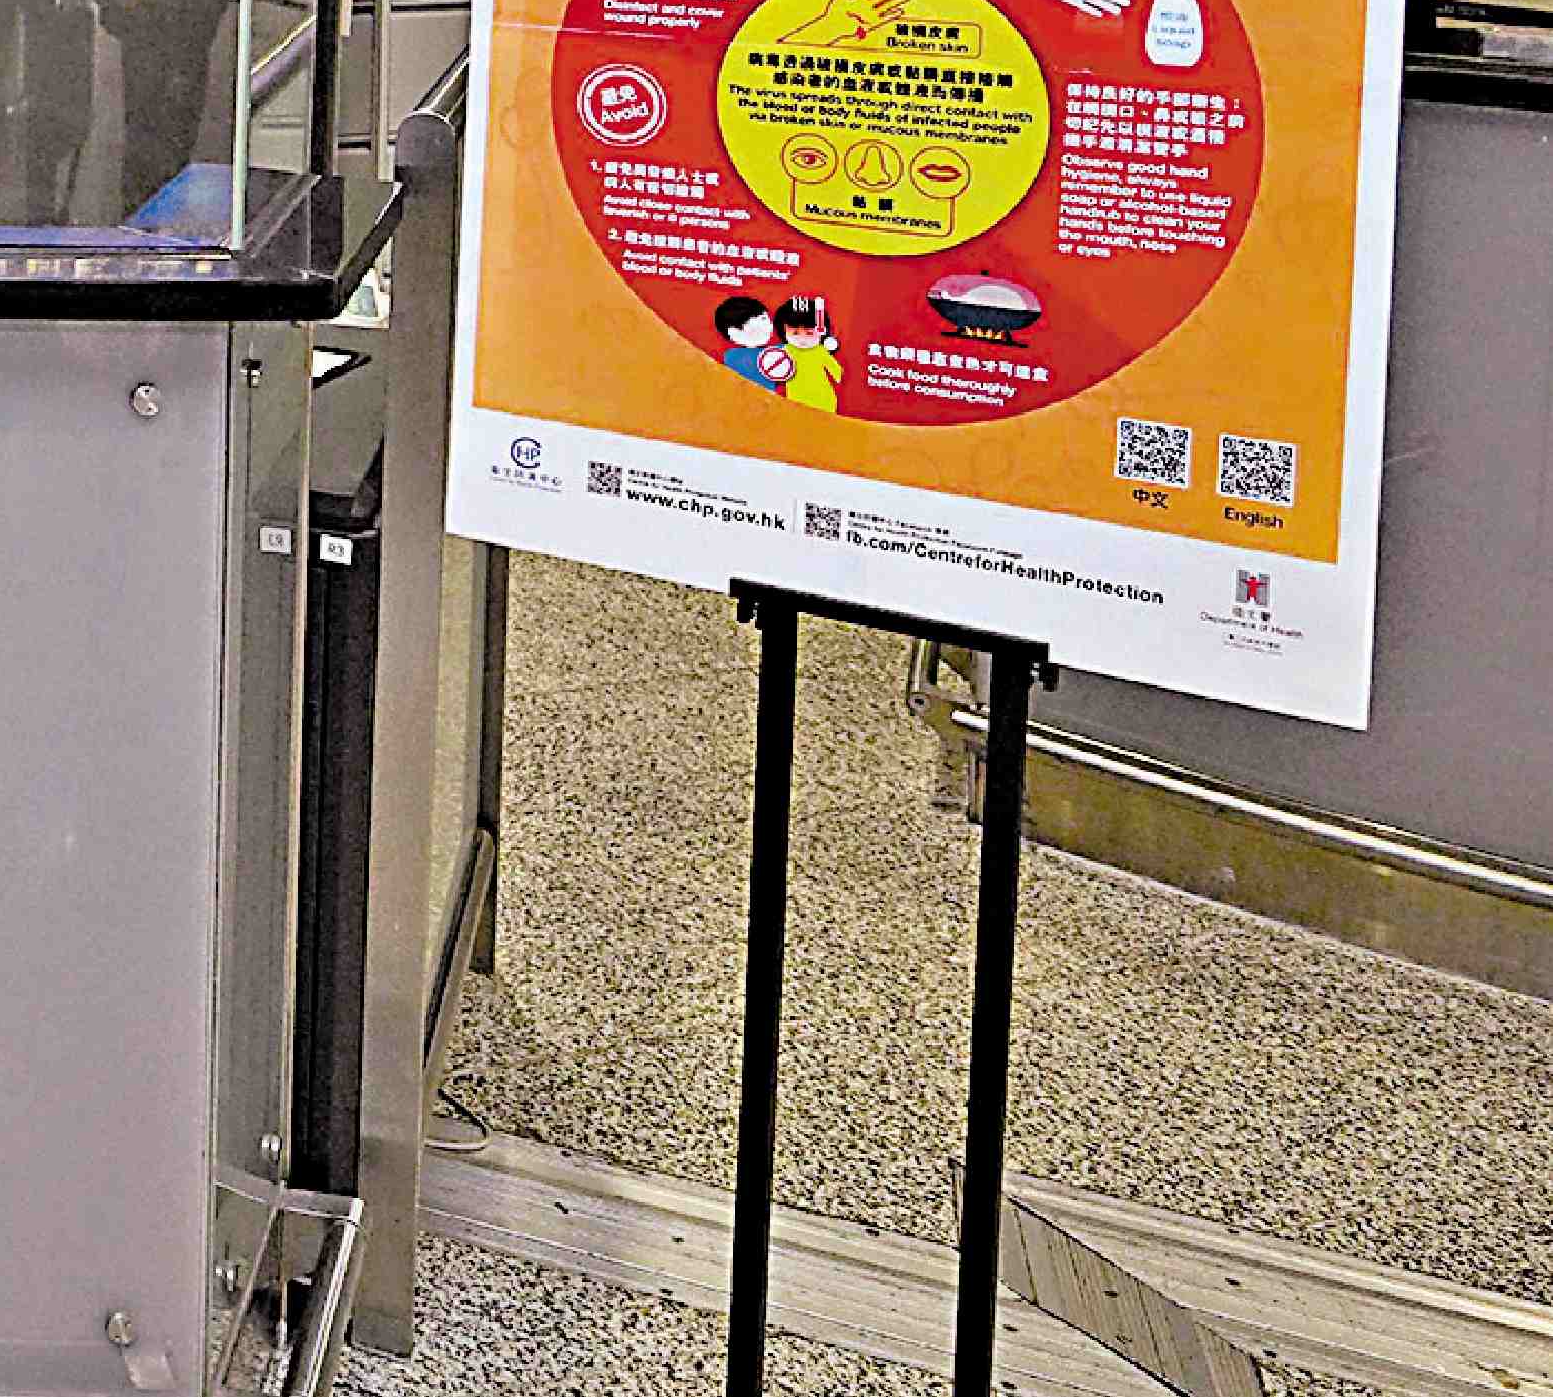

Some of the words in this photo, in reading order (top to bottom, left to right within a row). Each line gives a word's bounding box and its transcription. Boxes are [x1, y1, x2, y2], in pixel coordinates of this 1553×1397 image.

[886, 36, 936, 52] Broken
[939, 41, 969, 53] skin
[601, 101, 649, 124] Avoid
[819, 103, 850, 118] body
[911, 115, 969, 130] infected
[971, 121, 1022, 135] people
[846, 95, 897, 109] through
[901, 100, 942, 115] direct
[946, 105, 998, 120] contact
[1002, 109, 1033, 123] with
[1060, 166, 1123, 184] hygiene,
[1127, 175, 1177, 189] always
[1061, 153, 1124, 170] Observe
[1127, 163, 1166, 174] good
[1169, 164, 1209, 180] hand
[1060, 181, 1137, 196] remember
[1140, 187, 1154, 198] to
[1158, 192, 1186, 202] use
[1190, 193, 1232, 208] liquid
[805, 203, 857, 220] Mucous
[861, 208, 941, 229] membranes
[1060, 205, 1122, 220] handrub
[1143, 214, 1184, 228] clean
[1187, 220, 1222, 232] your
[1059, 217, 1104, 231] hands
[1107, 222, 1154, 237] before
[1158, 228, 1226, 249] touching
[867, 376, 911, 392] before
[914, 385, 1005, 407] consumption
[868, 364, 905, 379] Cook
[907, 369, 940, 384] food
[941, 375, 1017, 398] thoroughly
[625, 488, 786, 531] www.chp.gov.hk
[1132, 488, 1169, 510] 中文
[1224, 507, 1284, 529] English
[845, 529, 1165, 605] fb.com/CentreforHealthProtection
